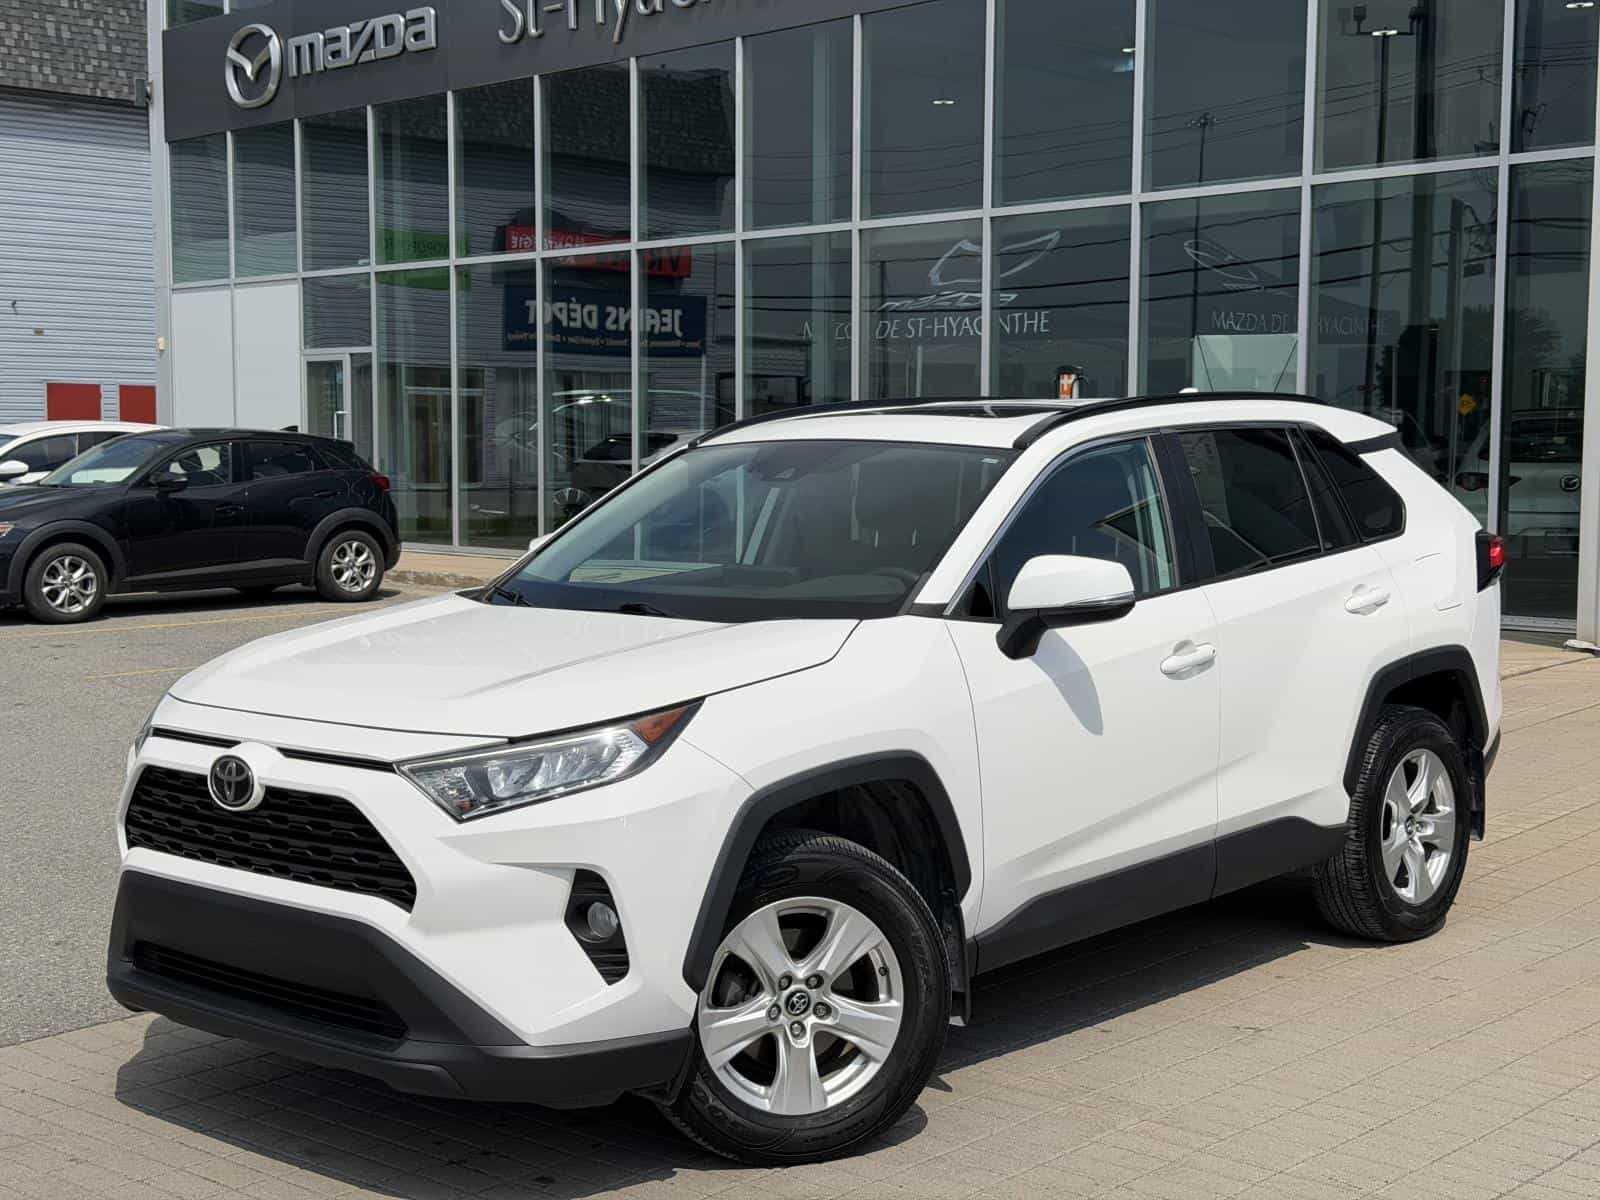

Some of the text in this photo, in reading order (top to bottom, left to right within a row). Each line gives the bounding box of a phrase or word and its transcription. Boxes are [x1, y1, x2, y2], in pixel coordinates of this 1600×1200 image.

[875, 319, 901, 340] DE
[905, 311, 1050, 338] ST-HYACNTHE
[1211, 311, 1267, 333] MAZDA
